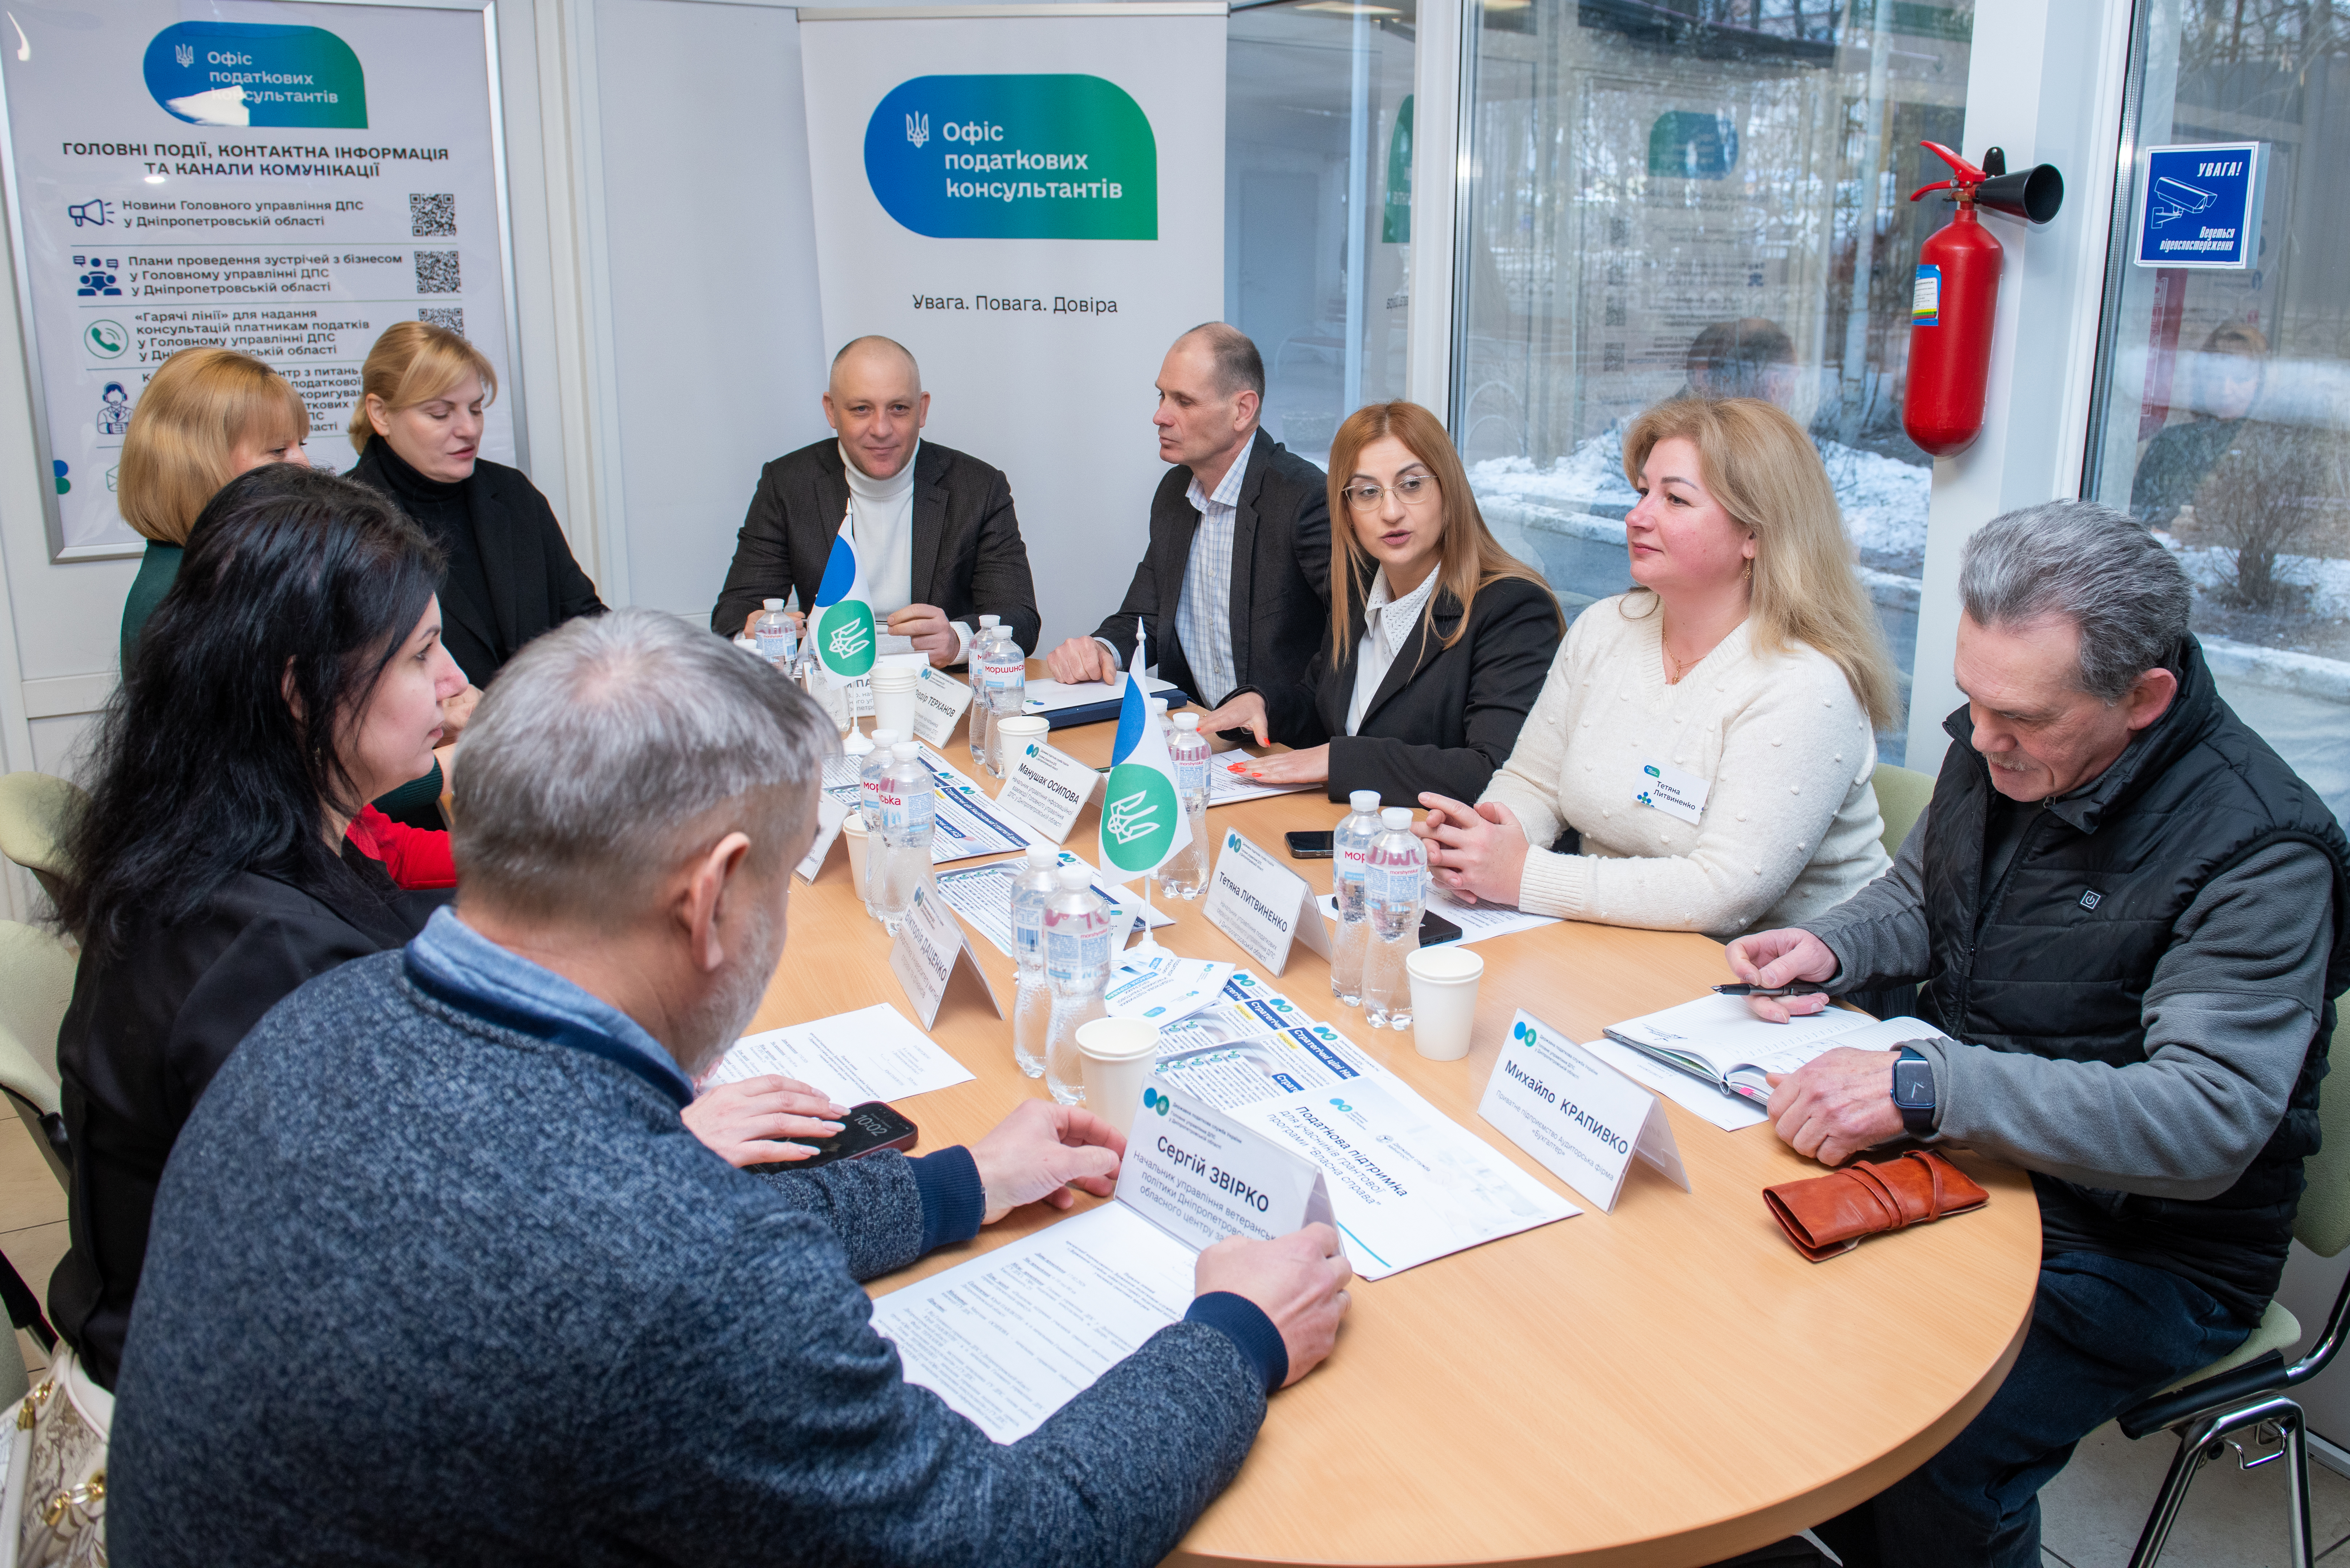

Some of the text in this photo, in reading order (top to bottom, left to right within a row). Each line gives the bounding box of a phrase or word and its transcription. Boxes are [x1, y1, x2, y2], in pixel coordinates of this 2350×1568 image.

[207, 51, 252, 67] Офіс
[210, 71, 314, 85] податкових
[943, 121, 1004, 145] Офіс
[62, 142, 449, 162] ГОЛОВНІ ПОДІЇ, КОНТАКТНА ІНФОРМАЦІЯ
[945, 150, 1088, 173] податкових
[144, 162, 379, 178] ТА КАНАЛИ КОМУНІКАЦІЇ
[2197, 162, 2242, 177] УВАГА!
[947, 178, 1123, 202] консультантів
[122, 201, 363, 212] Новини Головного управління ДПС
[125, 216, 324, 228] у Дніпропетровській області
[2199, 226, 2235, 241] Ведеться
[2160, 238, 2234, 253] відеоспостереження
[129, 256, 173, 266] Плани
[178, 257, 260, 267] проведення
[265, 255, 329, 266] зустрічей
[343, 254, 402, 264] бізнесом
[130, 269, 329, 282] у Головному управлінні ДПС
[132, 282, 331, 296] у Дніпропетровській області
[913, 294, 1117, 316] Увага. Повага. Довіра
[135, 310, 317, 323] «Гарячі лінії» для надання
[137, 320, 369, 335] консультацій платникам податків
[138, 333, 335, 349] у Головному управлінні ДПС
[139, 345, 337, 362] у області
[291, 377, 361, 388] податкової
[985, 664, 1025, 675] моршинсь
[928, 696, 956, 717] ТЕРХАНОВ
[1018, 763, 1079, 805] Манушак ОСИПОВА
[1657, 781, 1680, 795] Тетяна
[945, 788, 965, 803] Стратегічні
[1012, 776, 1073, 816] Начальник управління інформаційної
[1012, 786, 1064, 820] взаємодії Головного управління
[1653, 789, 1695, 810] Литвиненко
[1017, 797, 1049, 820] Дніпропетровській
[1048, 817, 1063, 828] області
[1220, 871, 1287, 932] Тетяна ЛИТВИНЕНКО
[1220, 900, 1277, 951] Начальник управління податкових
[905, 908, 923, 945] Вікторія
[920, 937, 947, 981] ДАЦЕНКО
[1221, 921, 1253, 952] Дніпропетровській
[1253, 948, 1267, 963] області
[1266, 949, 1275, 960] ДПС
[1294, 1030, 1331, 1060] Стратегічні
[1326, 1056, 1345, 1070] цілі
[1505, 1060, 1628, 1154] Михайло КРАПИВКО
[854, 1115, 887, 1137] 10:02
[1267, 1114, 1310, 1147] програми
[1496, 1090, 1614, 1181] Приватне підприємство Аудиторська фірма
[1279, 1110, 1387, 1194] для учасників грантової
[1295, 1106, 1351, 1150] Податкова
[1348, 1150, 1408, 1197] підтримка
[1532, 1129, 1565, 1156] «Бухгалтер»
[1133, 1151, 1175, 1183] Начальник
[1176, 1178, 1223, 1212] управління
[1142, 1171, 1176, 1199] політики
[1157, 1136, 1269, 1212] Сергій ЗВІРКО
[1140, 1185, 1213, 1238] обласного центру
